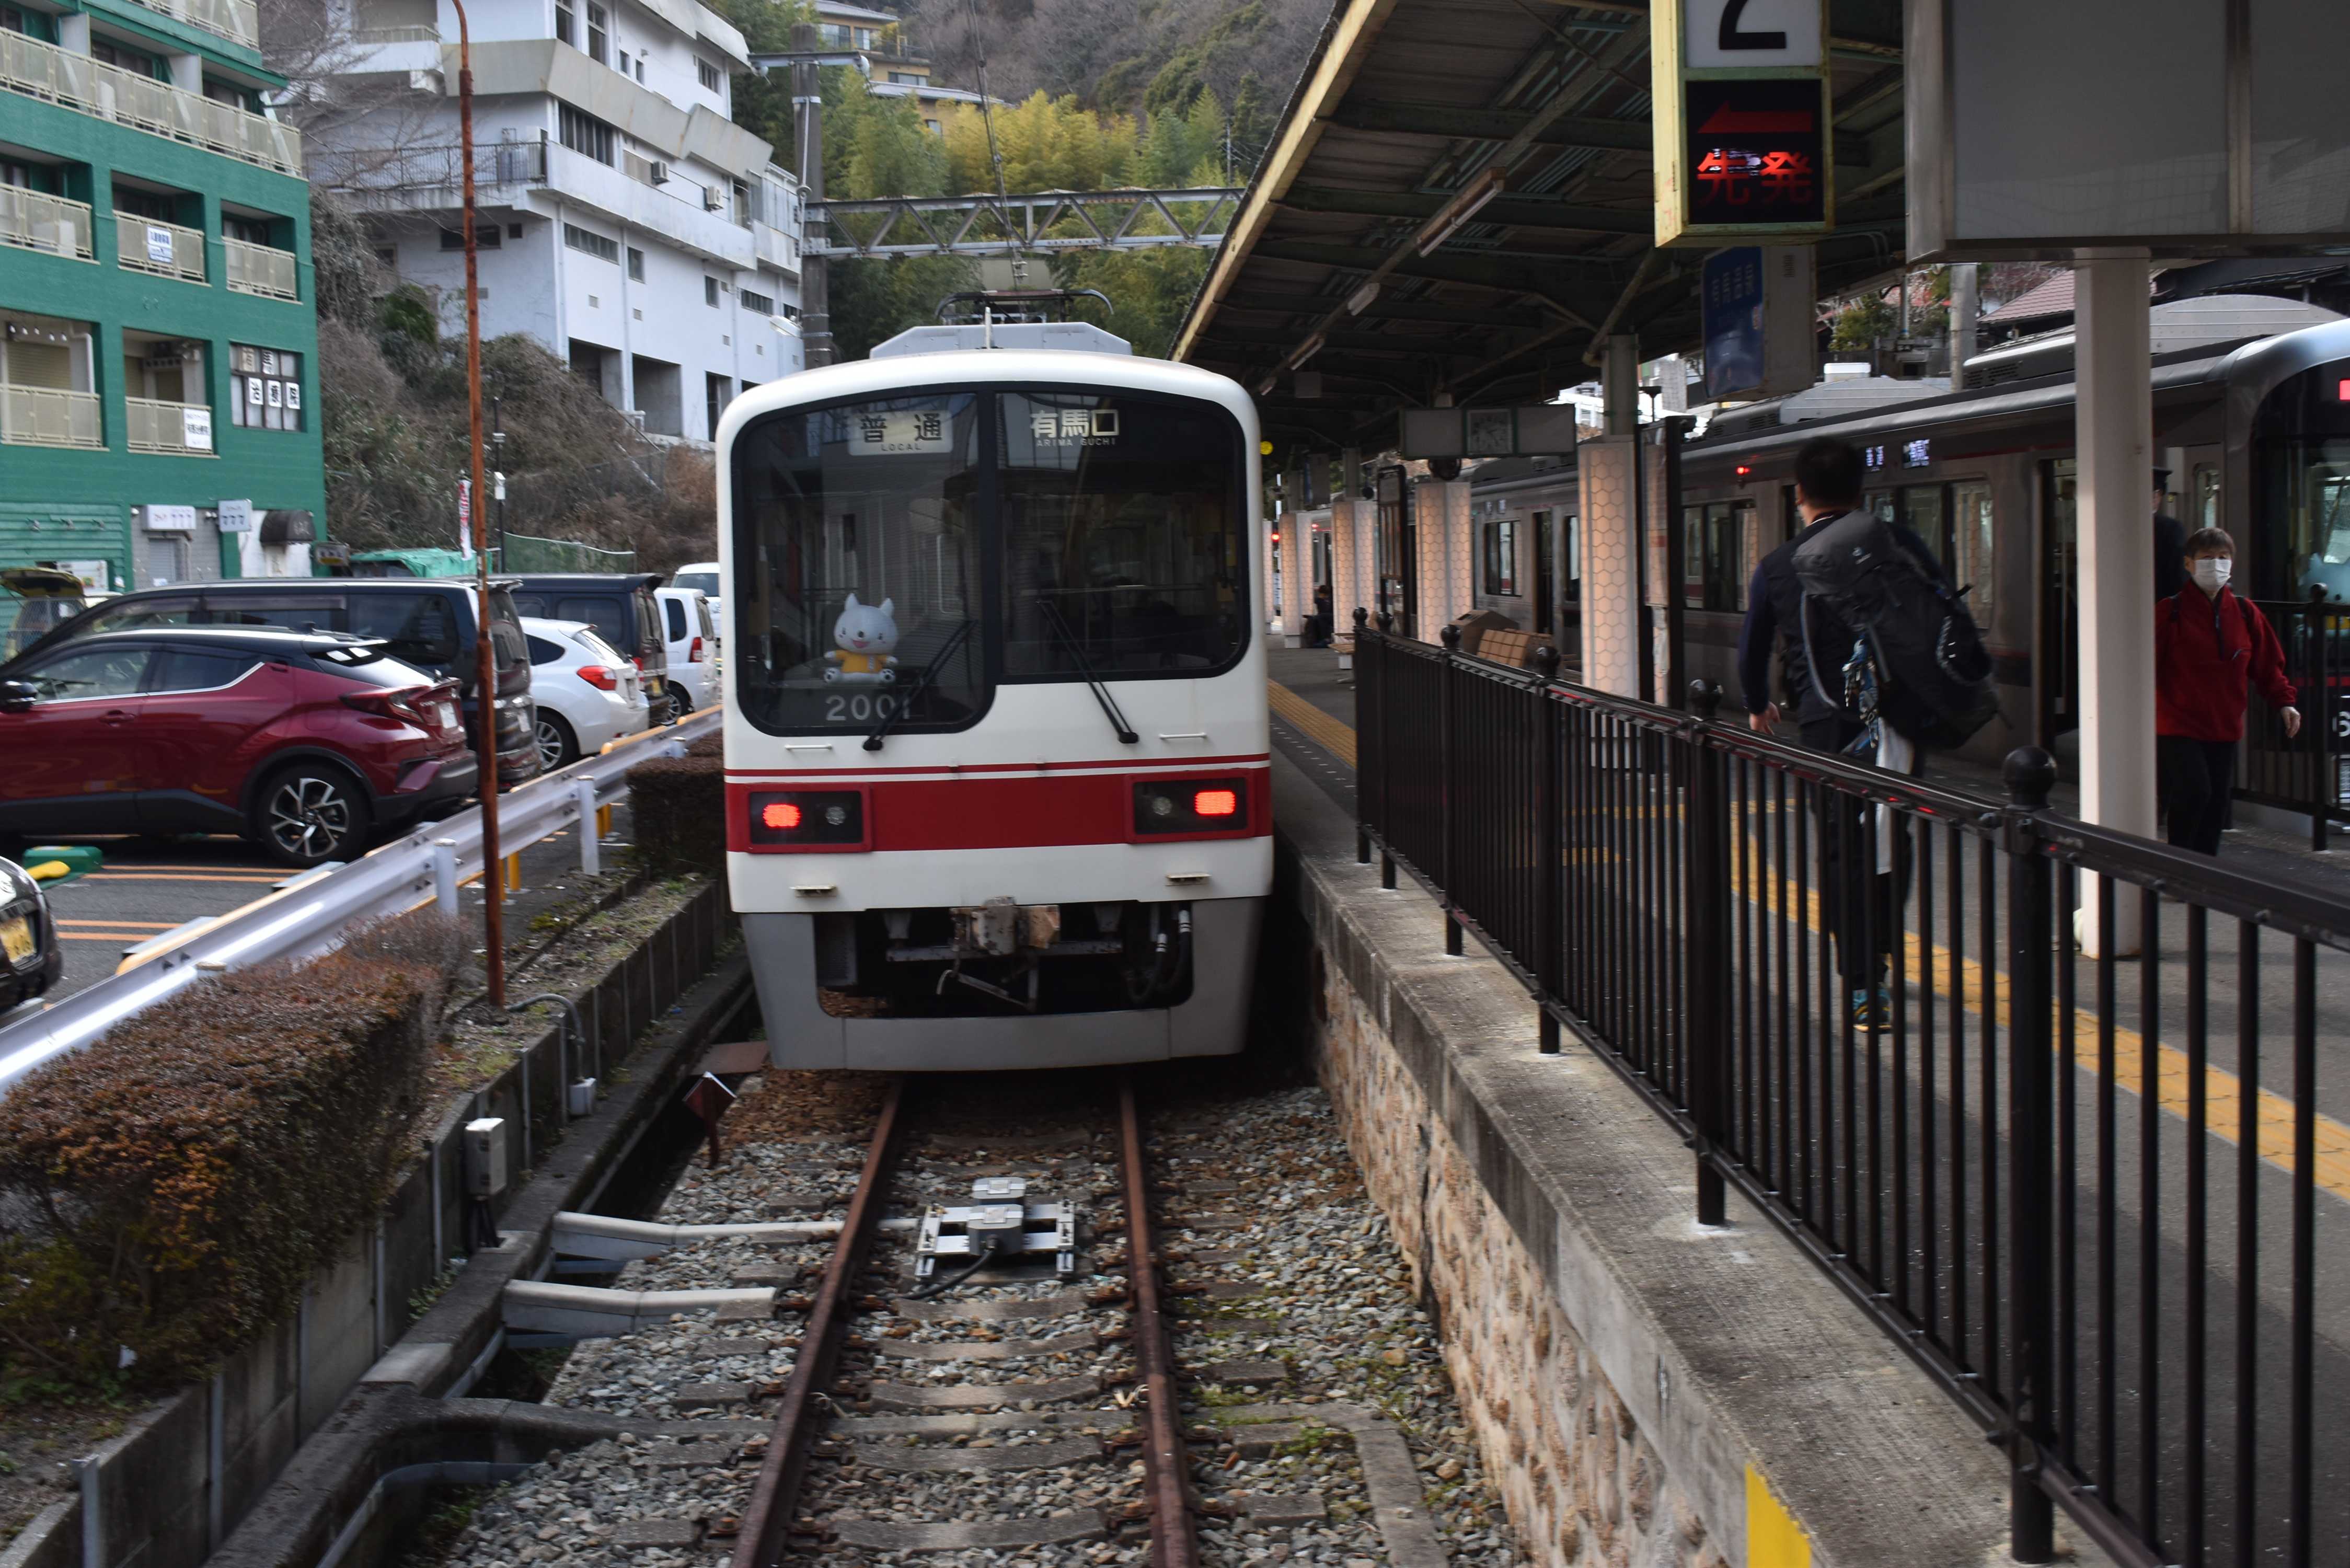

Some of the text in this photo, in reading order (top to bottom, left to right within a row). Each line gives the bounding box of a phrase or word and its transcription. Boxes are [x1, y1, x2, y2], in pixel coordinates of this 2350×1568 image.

[1696, 151, 1813, 206] 先発
[860, 412, 942, 443] 普通
[1030, 409, 1120, 439] 有馬口
[881, 443, 922, 452] LOCAL
[1036, 437, 1116, 447] ARIMA GUCHI
